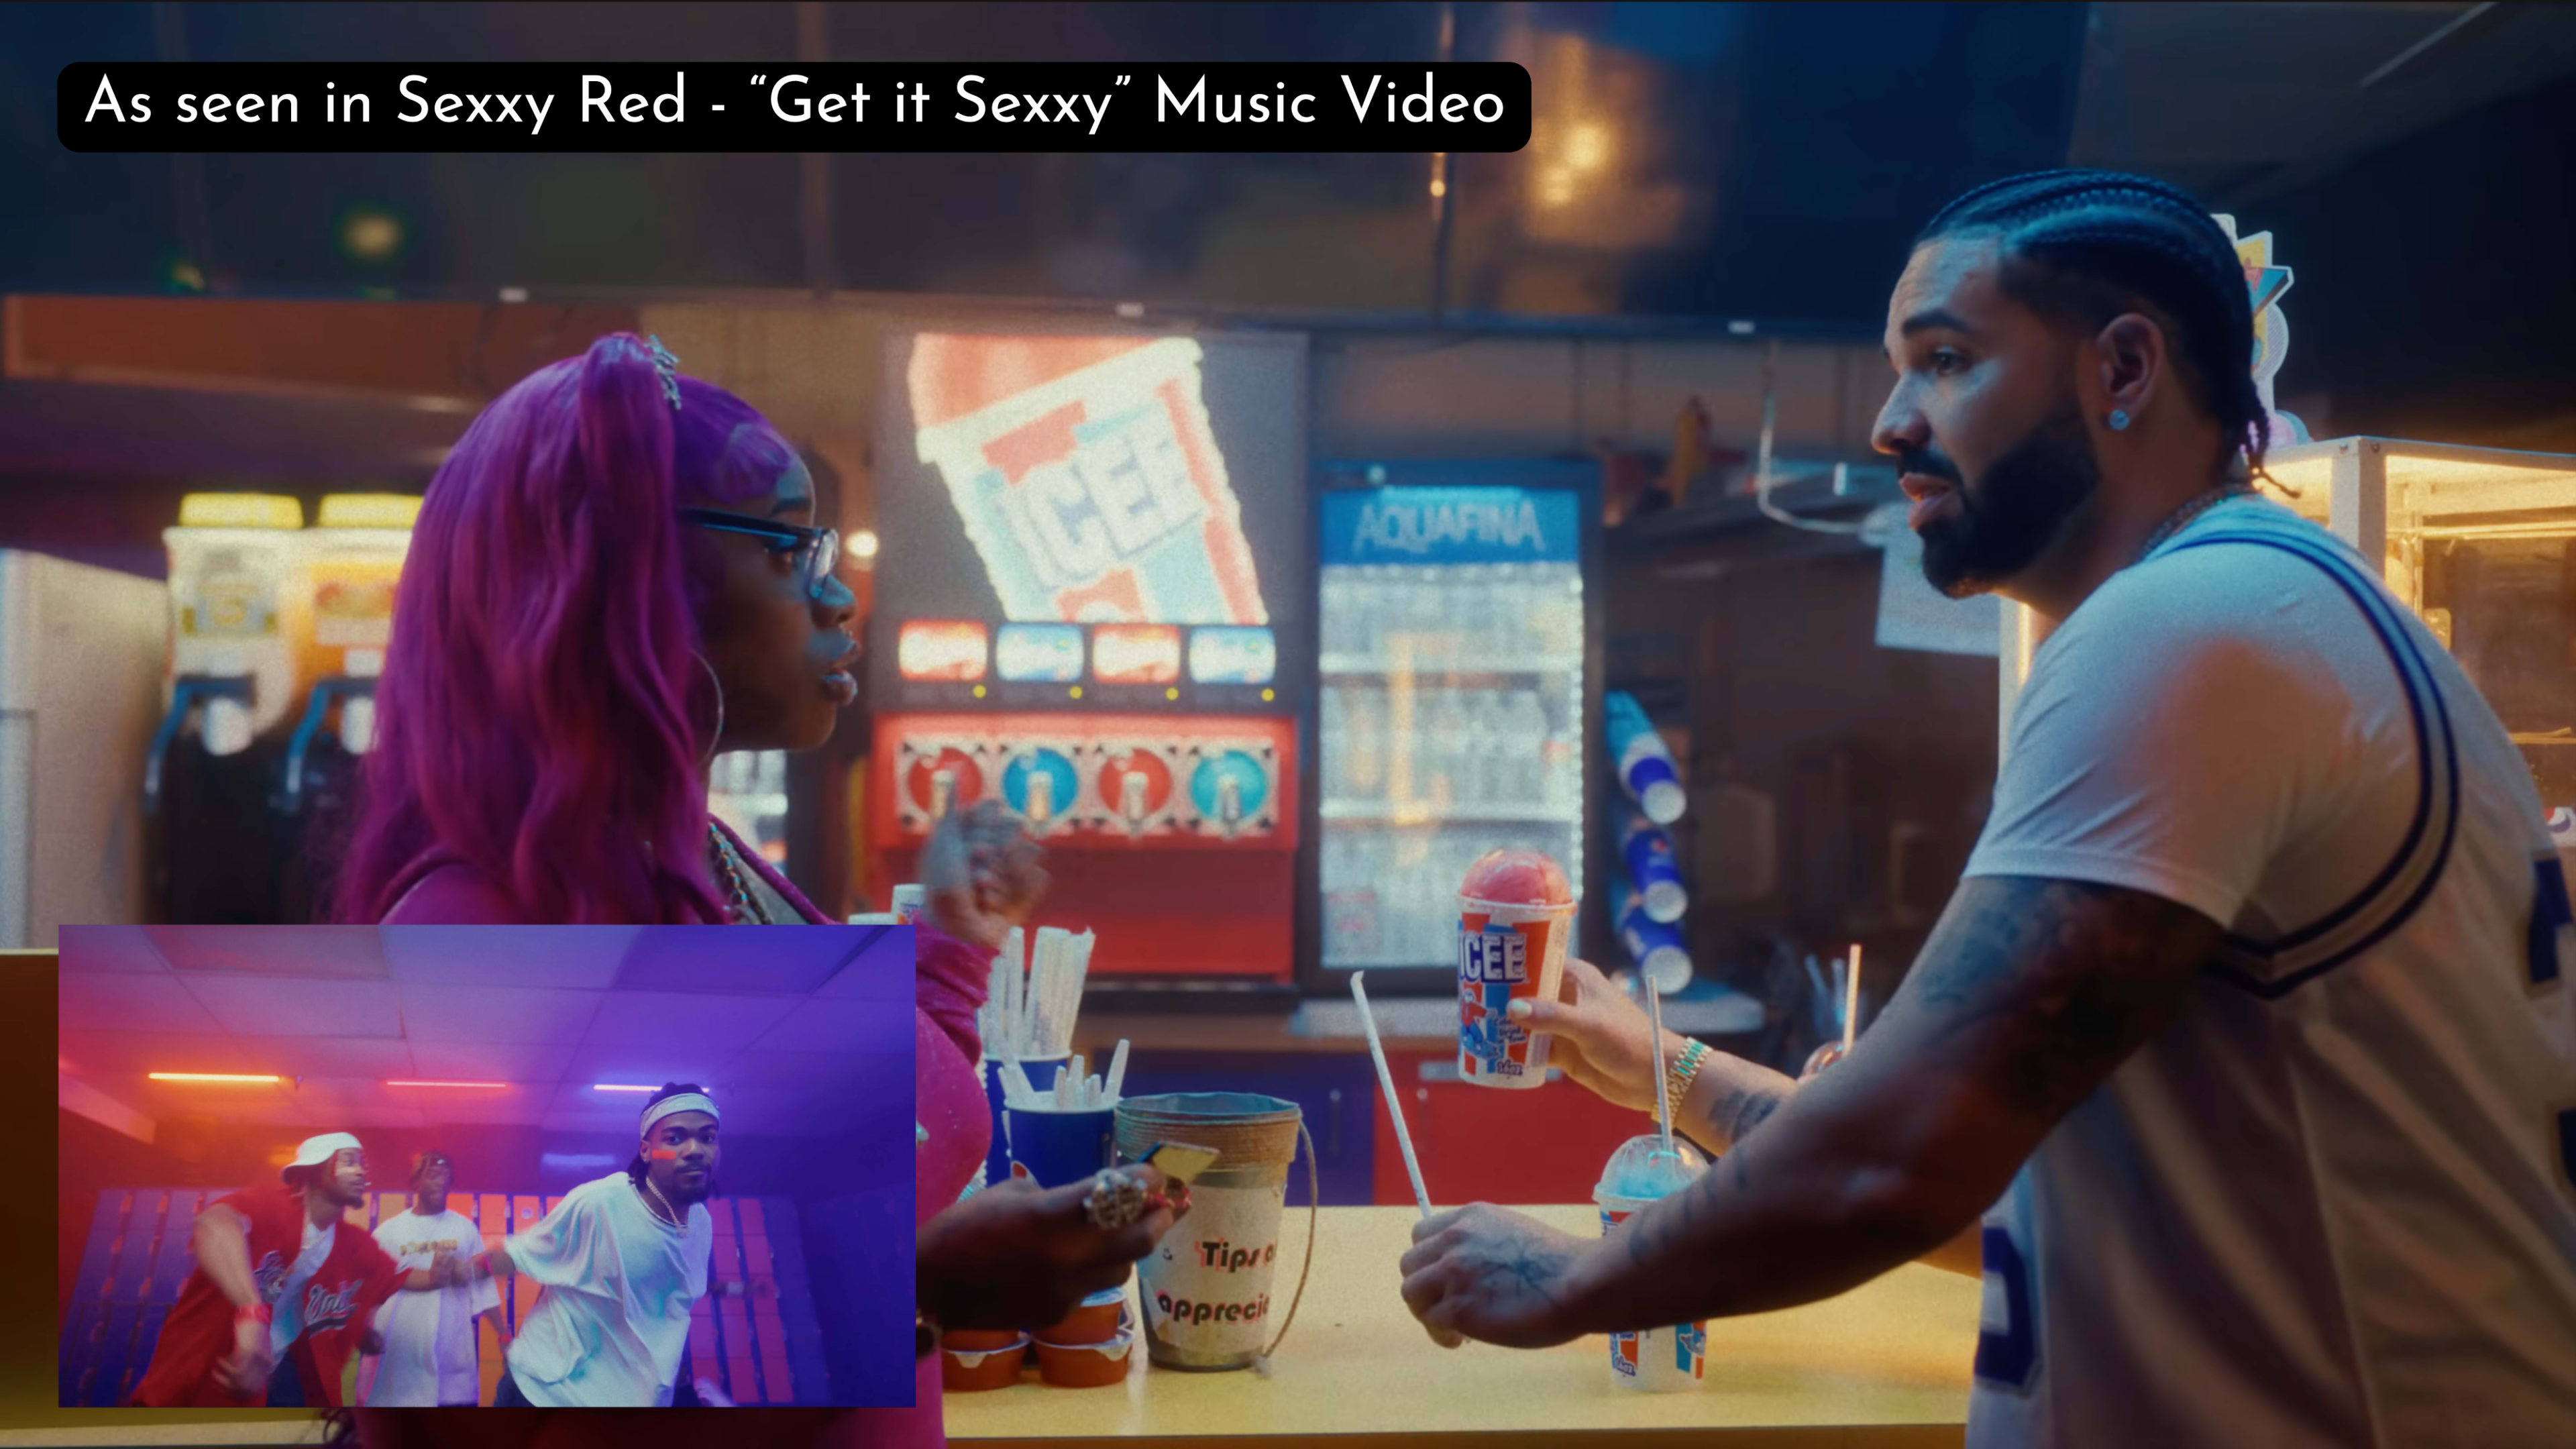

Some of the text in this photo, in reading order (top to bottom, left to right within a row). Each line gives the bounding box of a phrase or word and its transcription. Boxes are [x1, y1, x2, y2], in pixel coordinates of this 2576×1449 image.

[995, 411, 1205, 592] ICEE
[1352, 499, 1546, 555] AQUAFINA
[1459, 931, 1526, 983] ICEE
[1197, 1240, 1260, 1273] Tips
